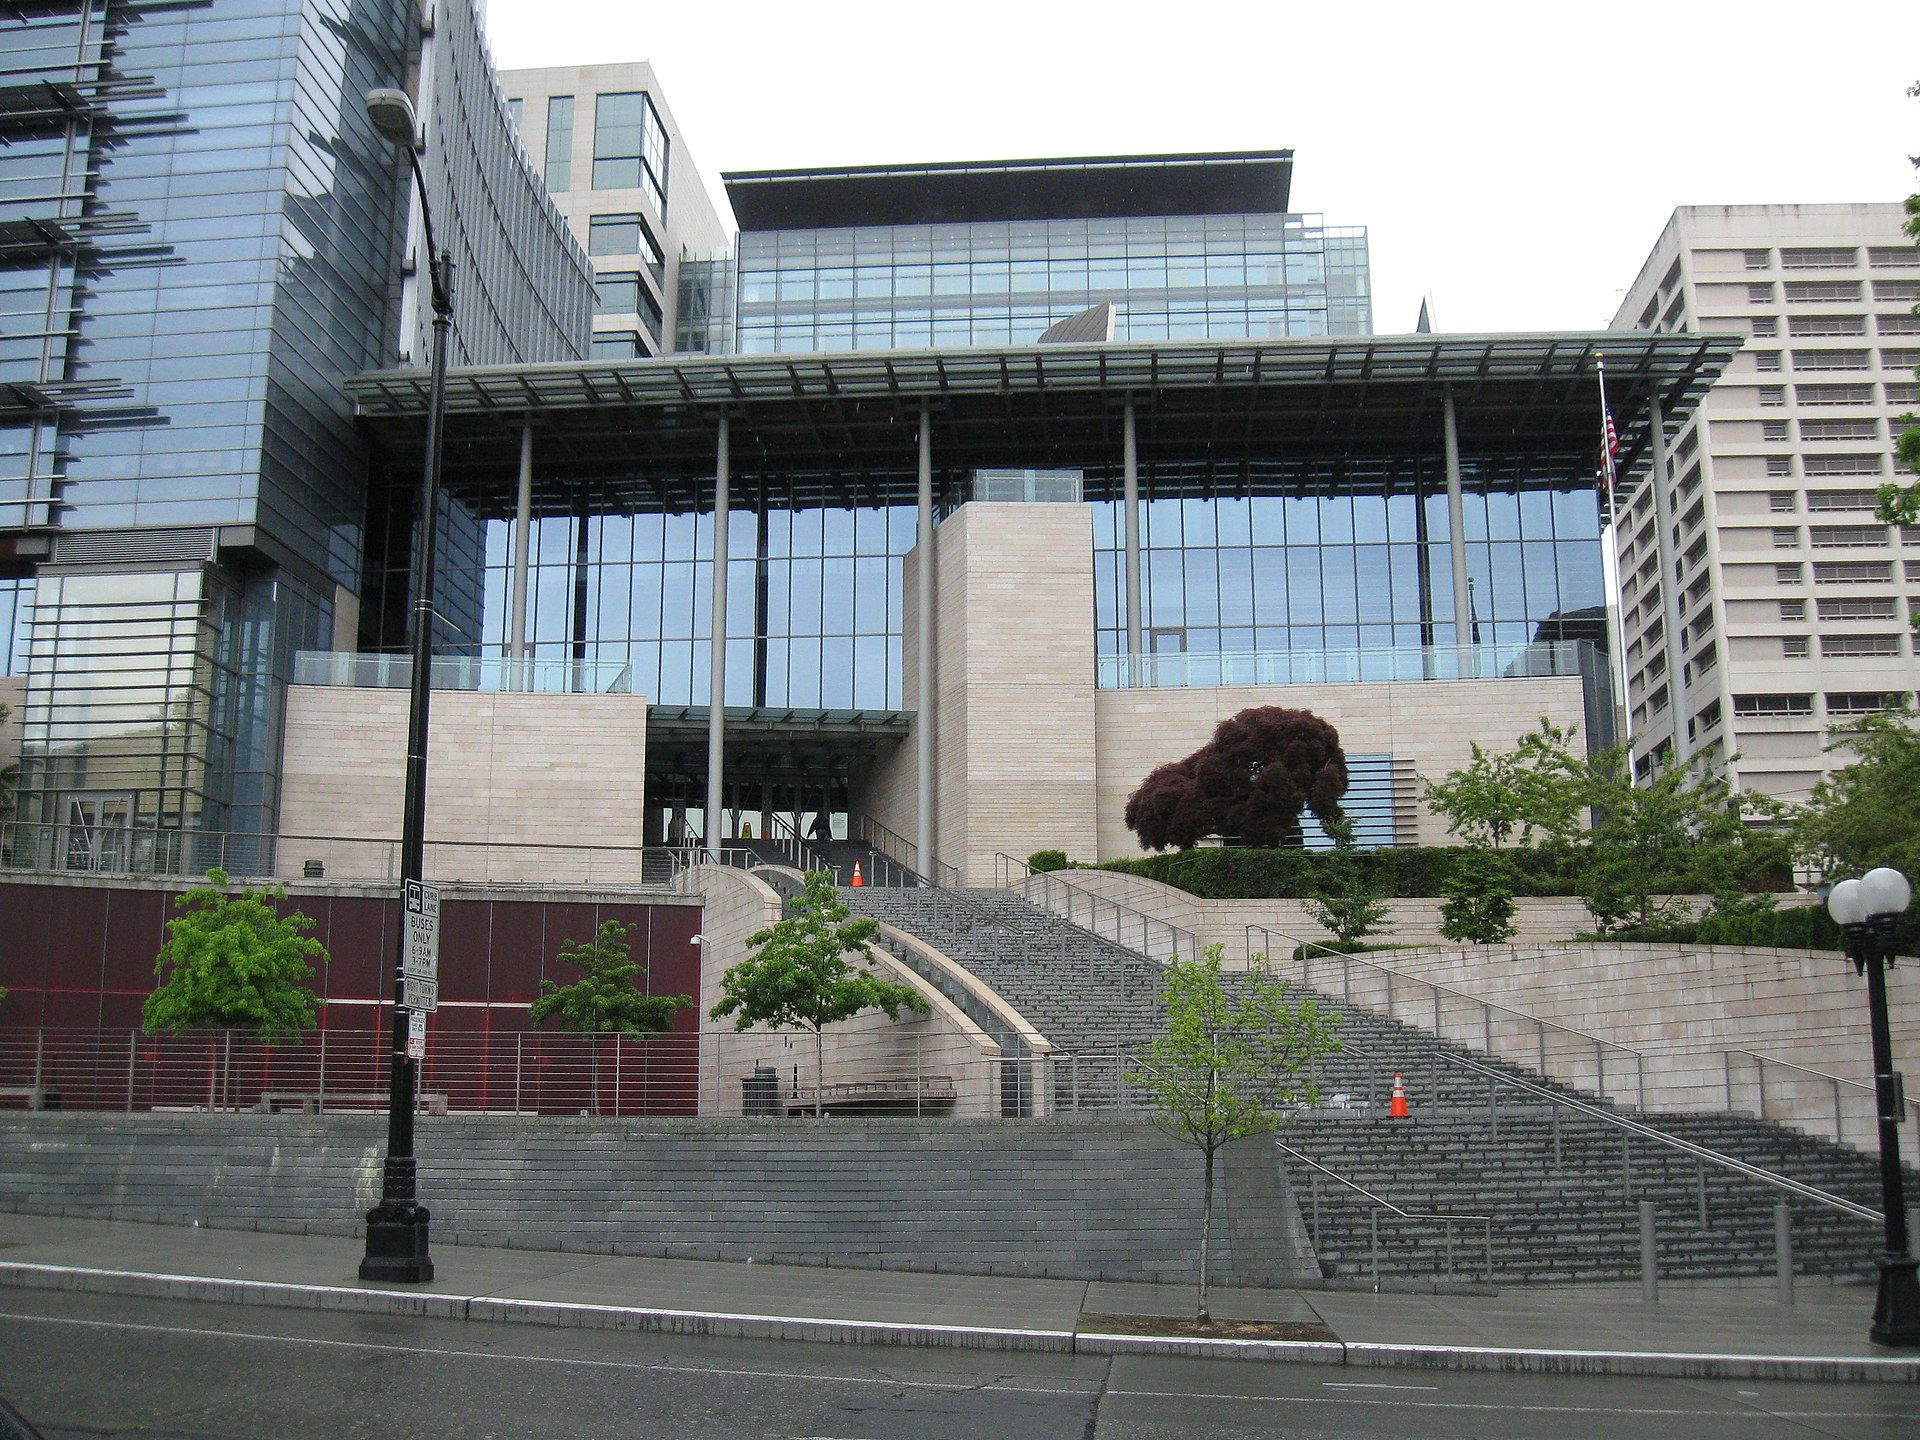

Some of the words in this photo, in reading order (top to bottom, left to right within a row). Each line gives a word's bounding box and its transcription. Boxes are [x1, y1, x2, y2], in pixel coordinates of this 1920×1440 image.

[424, 890, 438, 902] CURB
[424, 902, 437, 913] LANE
[411, 915, 434, 932] BUSES
[413, 930, 431, 945] ONLY
[411, 945, 432, 958] 6-9AM
[411, 956, 431, 968] 3-7PM
[420, 982, 435, 996] TURNS
